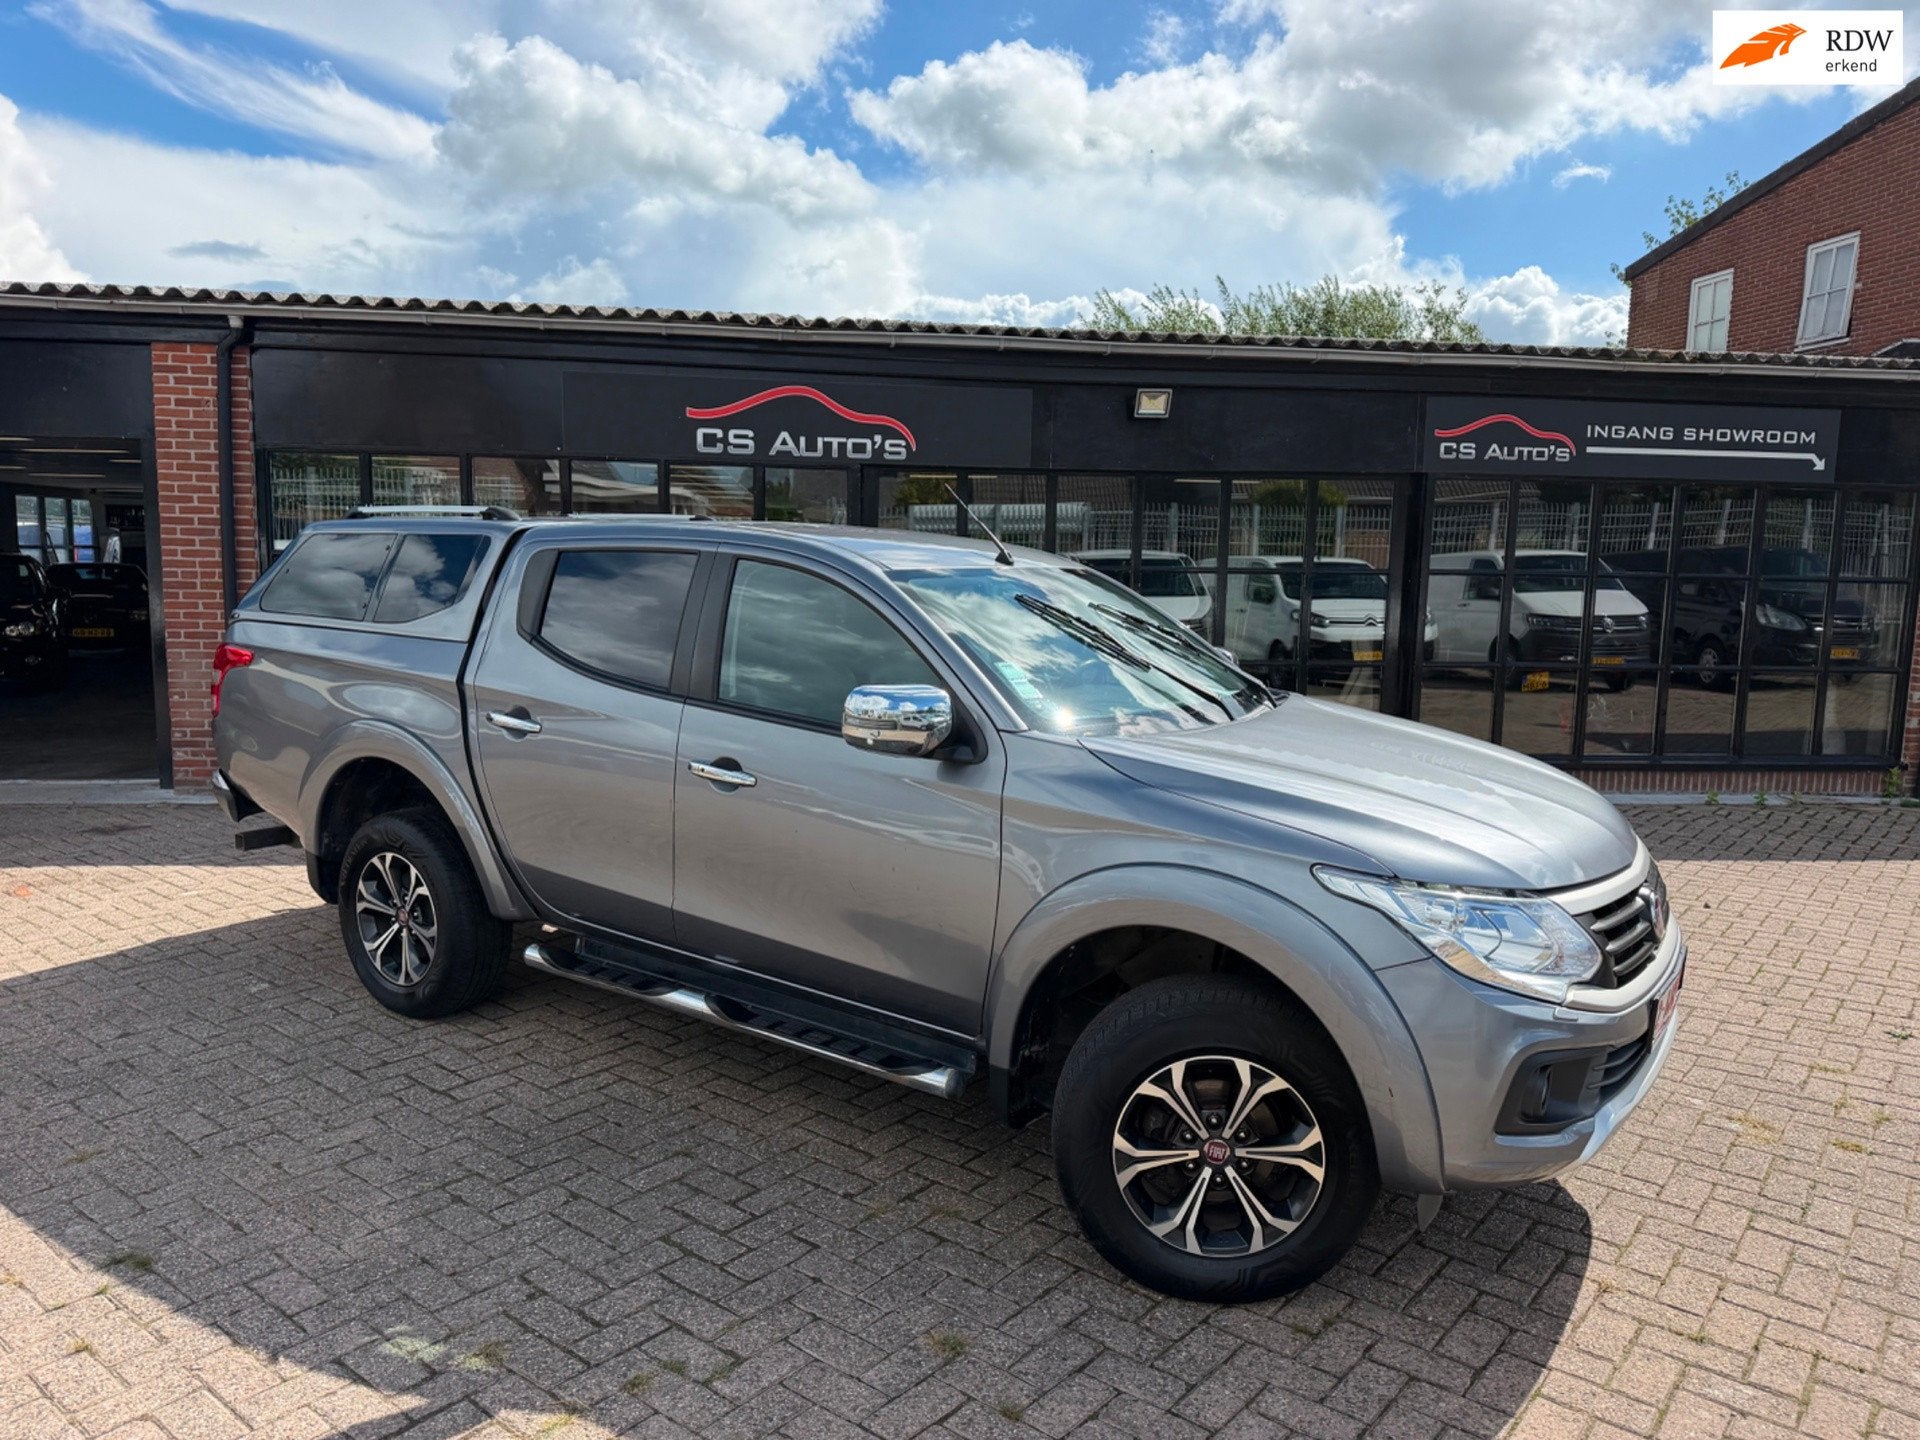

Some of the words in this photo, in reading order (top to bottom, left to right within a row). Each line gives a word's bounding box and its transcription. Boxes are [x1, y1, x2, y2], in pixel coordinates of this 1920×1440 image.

[696, 427, 755, 455] CS
[768, 430, 907, 461] AUTO'S
[1586, 424, 1675, 441] INGANG
[1683, 427, 1816, 445] SHOWROOM
[1439, 442, 1476, 460] CS
[1484, 443, 1571, 462] AUTO'S
[1209, 1145, 1226, 1160] FIAT
